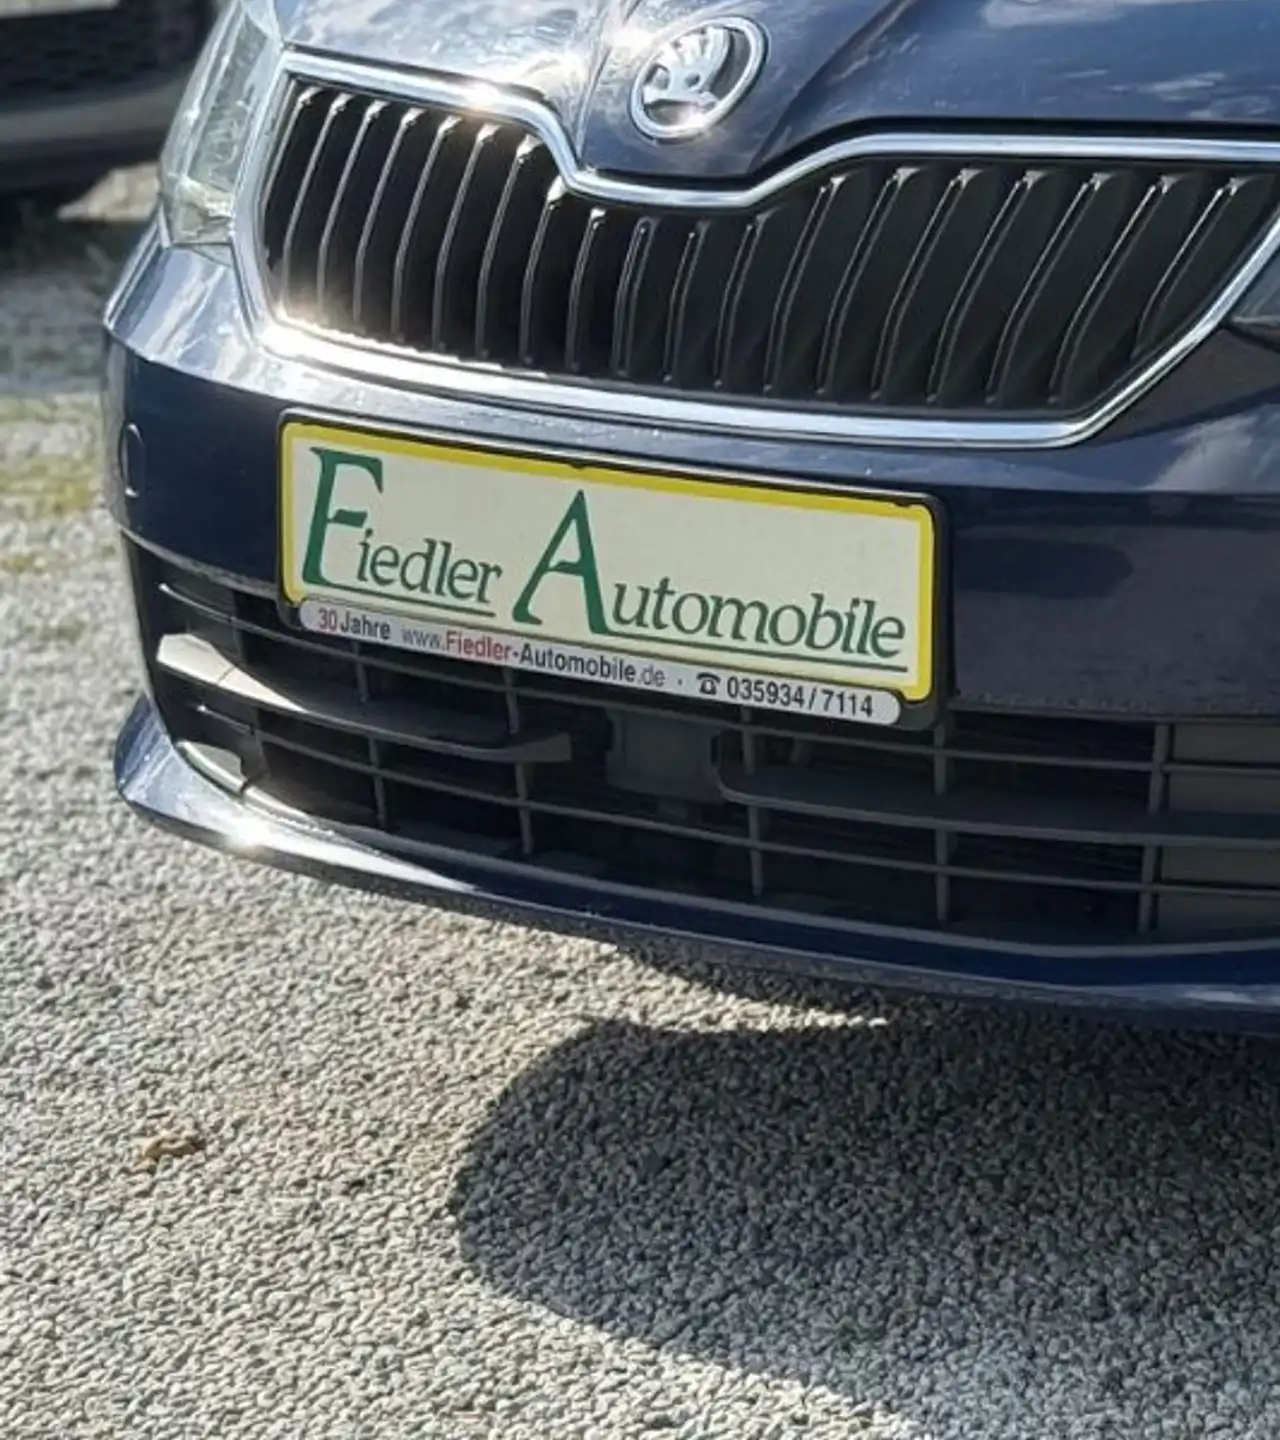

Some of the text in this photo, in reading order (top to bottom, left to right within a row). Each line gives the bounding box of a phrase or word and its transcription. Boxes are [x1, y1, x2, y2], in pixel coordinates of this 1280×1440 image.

[302, 446, 906, 660] Fiedler Automobile
[340, 613, 391, 640] Jahre
[401, 626, 666, 688] www.Fiedler-Automobile.de
